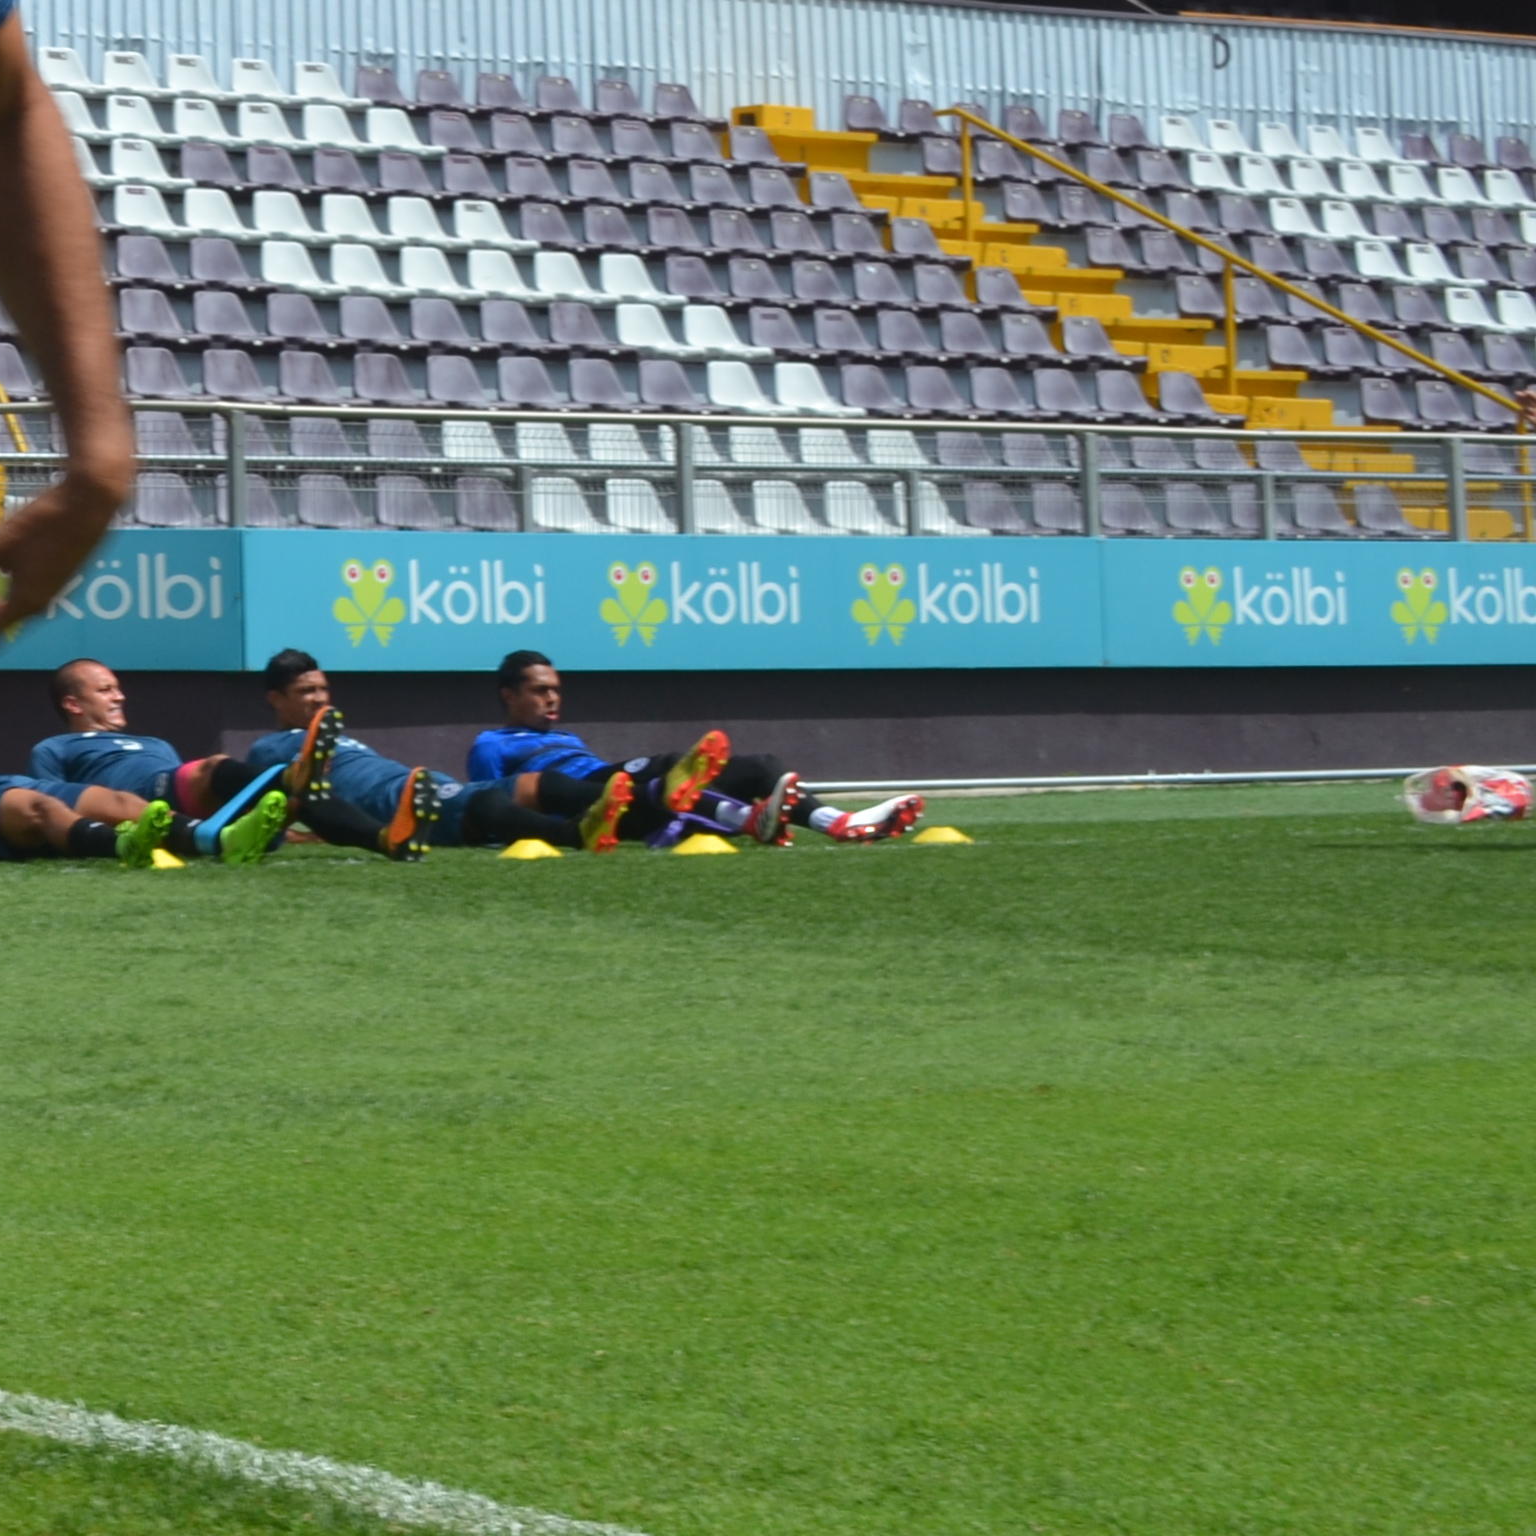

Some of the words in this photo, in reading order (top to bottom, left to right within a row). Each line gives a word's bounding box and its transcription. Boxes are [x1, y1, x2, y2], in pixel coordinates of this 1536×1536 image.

[1212, 32, 1230, 70] D
[46, 553, 222, 620] kölbi
[408, 559, 546, 625] kölbi
[671, 561, 800, 625] kölbi
[918, 563, 1040, 625] kölbi
[1234, 566, 1347, 626] kölbi
